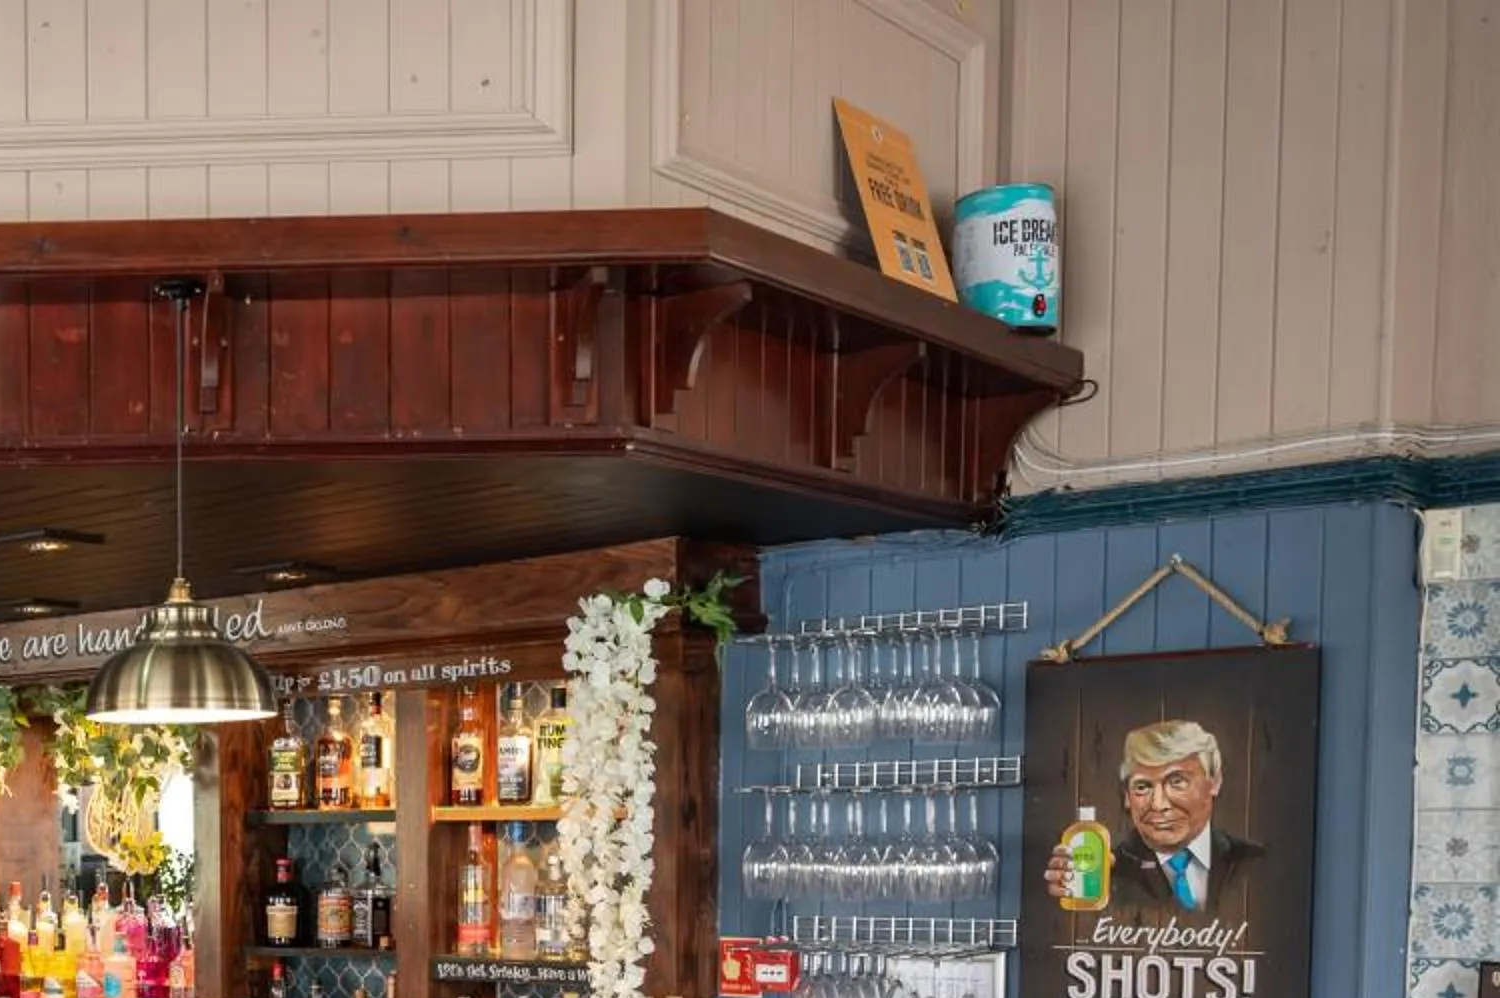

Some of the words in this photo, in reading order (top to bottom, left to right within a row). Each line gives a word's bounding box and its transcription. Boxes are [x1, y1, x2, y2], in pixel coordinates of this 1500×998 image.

[993, 220, 1018, 246] ICE
[23, 632, 69, 658] are
[317, 665, 381, 690] £1.50
[383, 668, 407, 684] on
[410, 664, 436, 681] all
[440, 656, 512, 682] spirits
